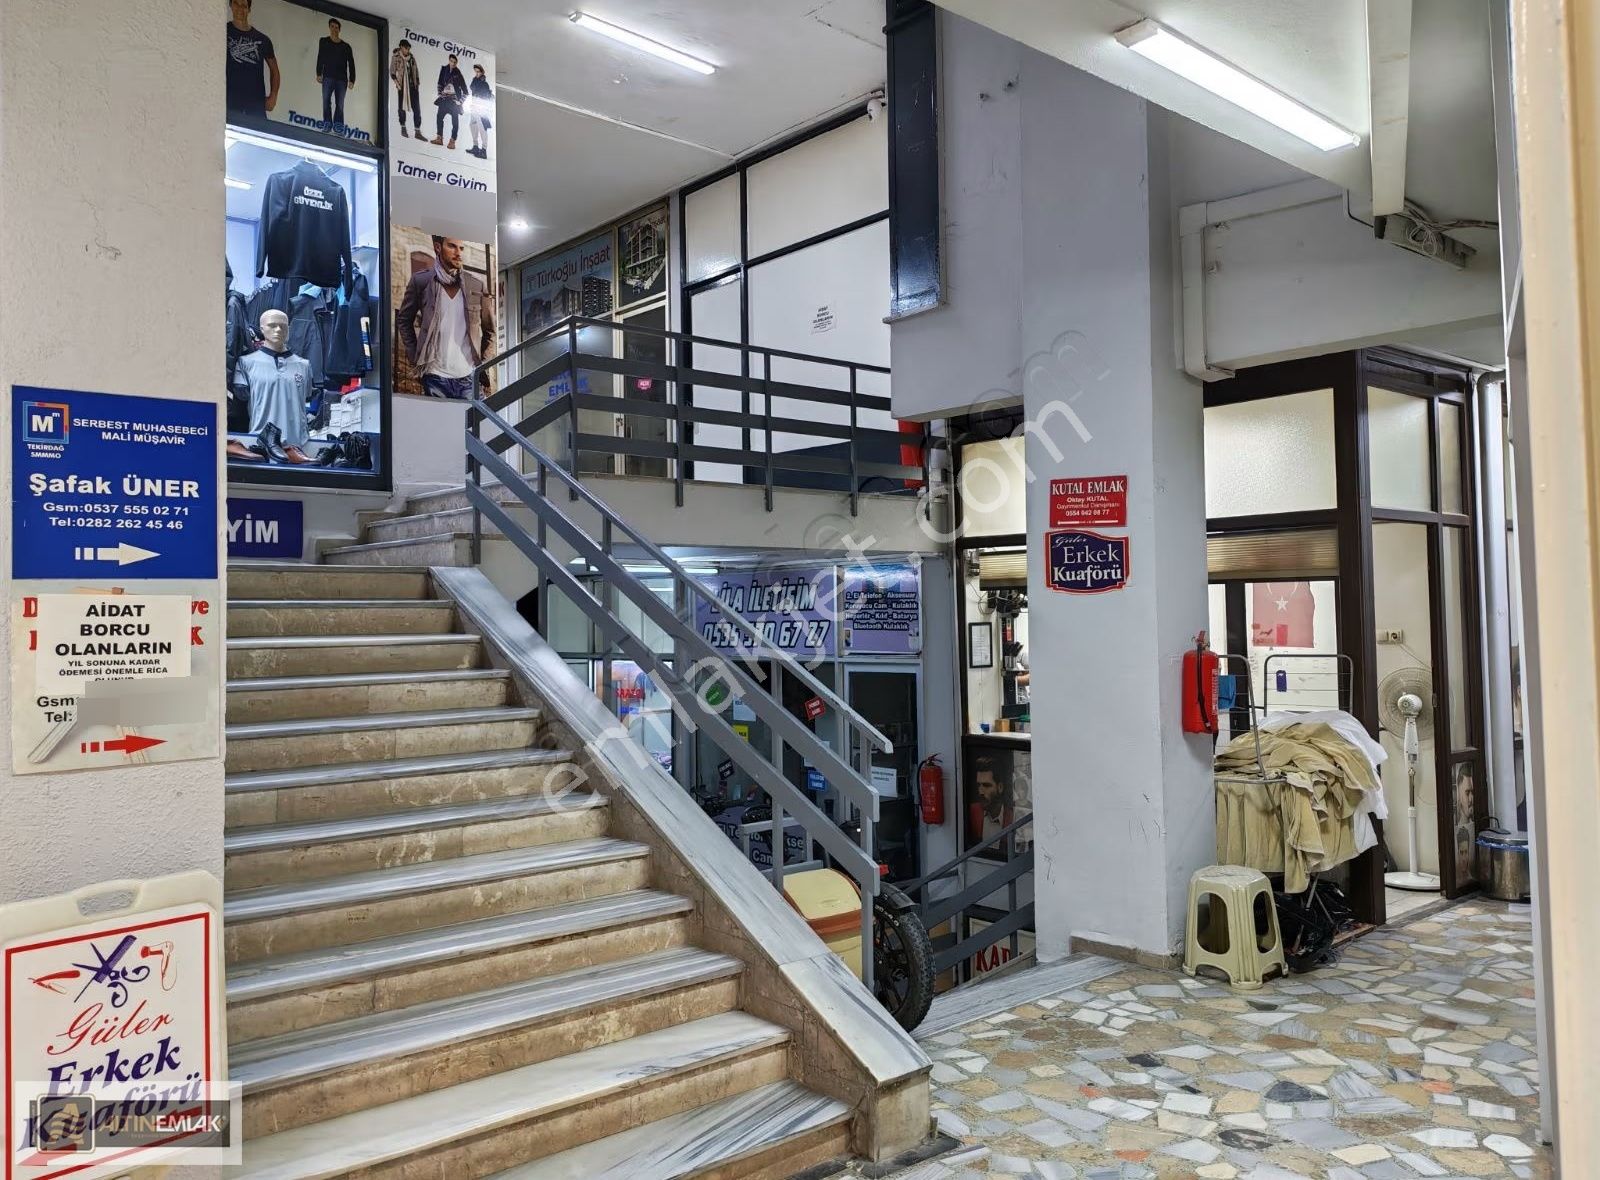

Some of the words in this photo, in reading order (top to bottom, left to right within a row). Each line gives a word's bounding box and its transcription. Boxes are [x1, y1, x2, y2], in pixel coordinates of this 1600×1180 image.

[404, 28, 440, 48] Tamer
[443, 41, 477, 60] Giyim
[288, 110, 332, 130] Tamer
[333, 121, 371, 141] Giyim
[397, 160, 442, 182] Tamer
[304, 185, 324, 199] ÖZEL
[537, 261, 577, 288] Türkoğlu
[581, 245, 611, 272] İnşaat
[73, 418, 129, 430] SERBEST
[133, 422, 208, 436] MUHASEBECİ
[102, 431, 131, 441] MALİ
[134, 433, 185, 445] MÜŞAVİR
[27, 443, 65, 452] TEKİRDAĞ
[29, 473, 112, 496] Şafak
[122, 474, 200, 498] ÜNER
[1052, 482, 1084, 495] KUTAL
[1088, 480, 1124, 494] EMLAK
[43, 502, 119, 514] Gsm:0537
[124, 504, 149, 515] 555
[153, 505, 170, 516] 02
[173, 506, 189, 516] 71
[49, 517, 112, 528] Tel:0282
[116, 518, 142, 529] 262
[146, 519, 163, 530] 45
[166, 520, 183, 530] 46
[1063, 544, 1120, 564] Erkek
[1053, 564, 1122, 588] Kuaförü
[86, 602, 145, 617] AİDAT
[80, 624, 150, 636] BORCU
[779, 621, 803, 648] 67
[55, 642, 172, 656] OLANLARIN
[59, 666, 102, 676] ÖDEMESİ
[105, 666, 144, 675] ÖNEMLE
[146, 665, 168, 674] RİCA
[86, 659, 126, 667] SONUNA
[129, 658, 160, 666] KADAR
[45, 711, 73, 722] Tel:
[47, 1000, 174, 1055] Güler
[43, 1036, 181, 1103] Erkek
[17, 1072, 202, 1152] Kuaförü
